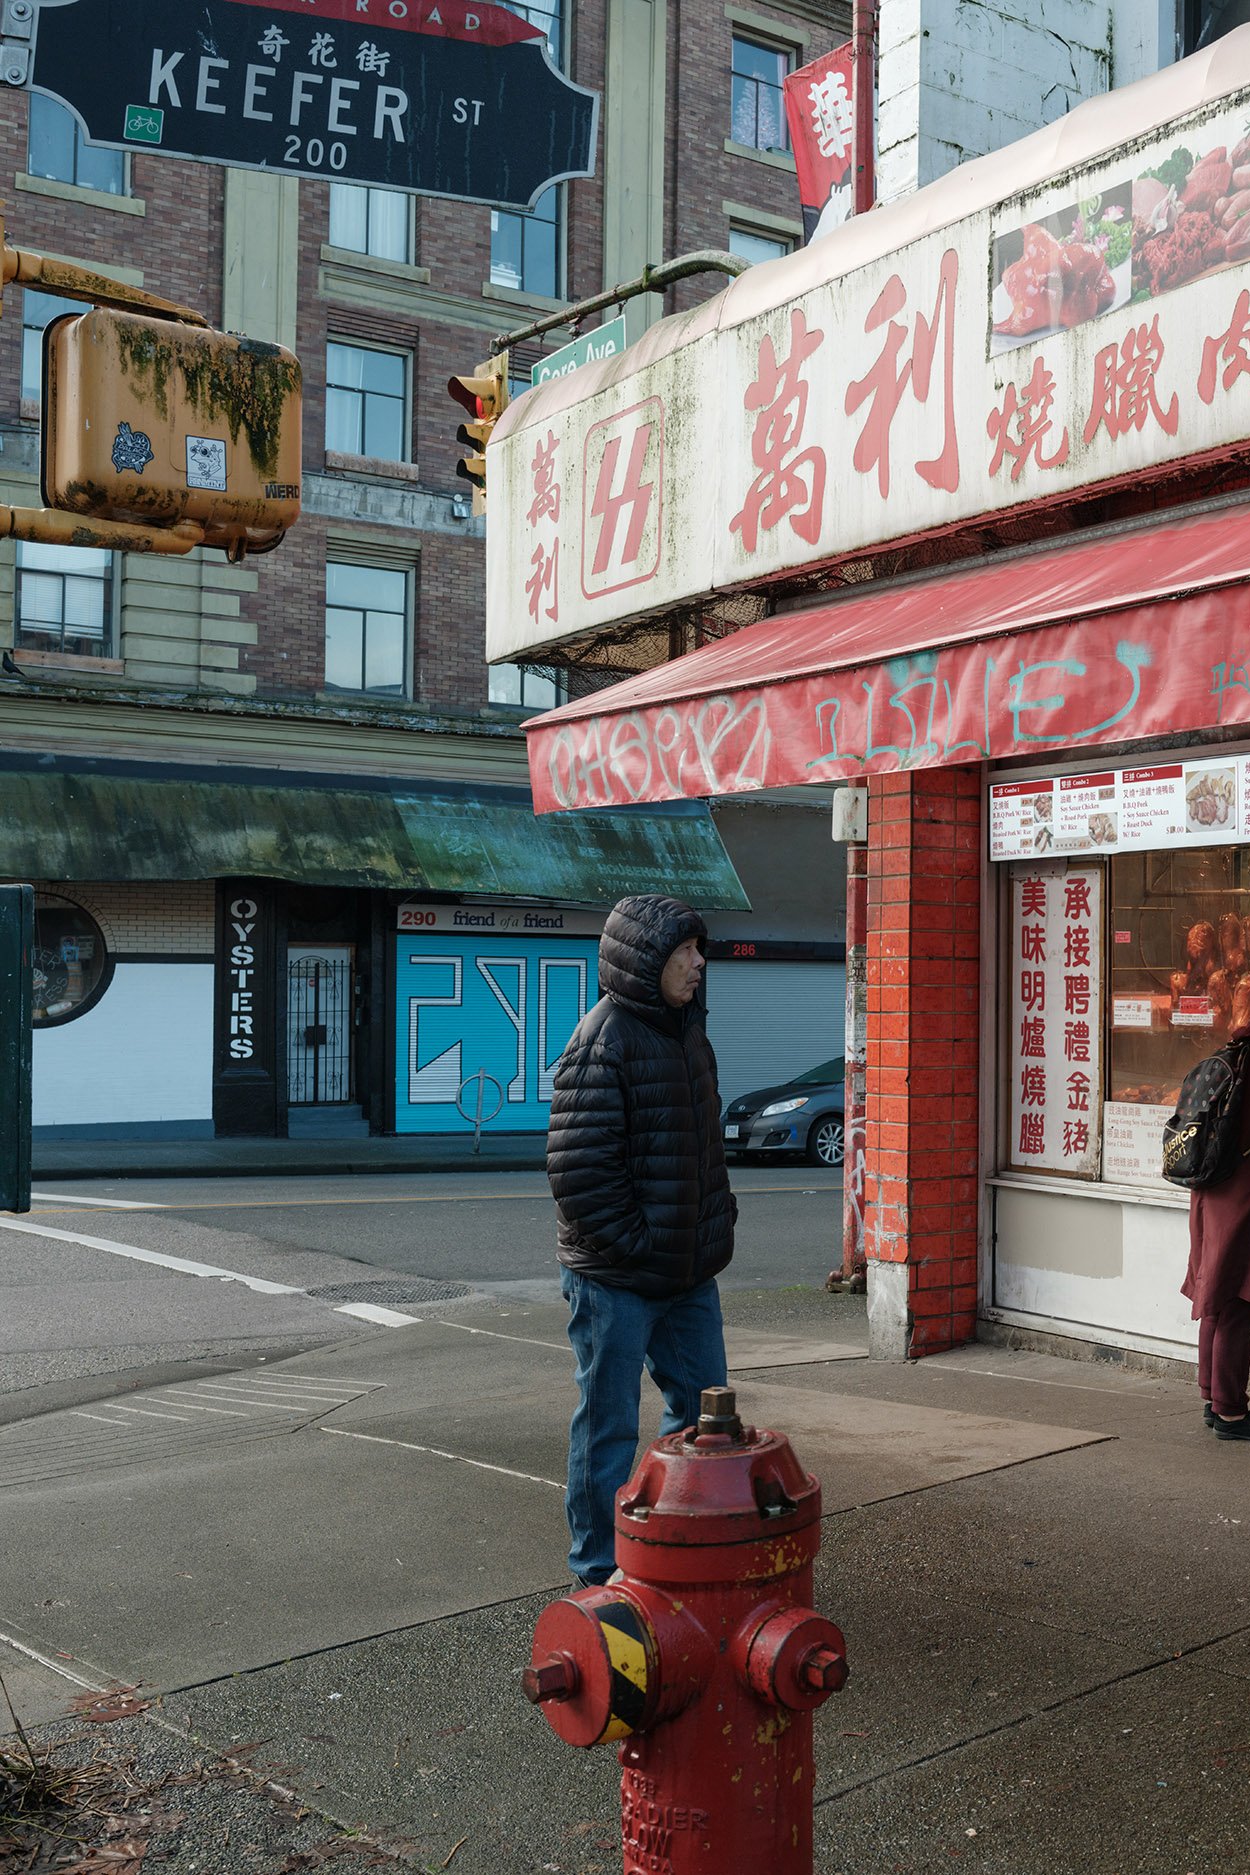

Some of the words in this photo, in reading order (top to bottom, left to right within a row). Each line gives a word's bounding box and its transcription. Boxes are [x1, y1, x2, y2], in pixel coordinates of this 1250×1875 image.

[257, 24, 390, 77] 奇花街
[356, 0, 481, 31] ROAD
[149, 48, 410, 143] KEEFER
[452, 97, 485, 126] ST
[283, 135, 347, 170] 200
[586, 339, 616, 362] Ave
[729, 247, 959, 553] 萬利
[525, 430, 561, 623] 萬利
[401, 911, 436, 927] 290
[453, 910, 495, 926] friend
[523, 913, 564, 929] friend
[733, 944, 756, 956] 286
[230, 899, 258, 1058] OYSTERS
[1019, 876, 1047, 1155] 美味明爐燒臘
[1063, 877, 1091, 1157] 承接聘禮金豬
